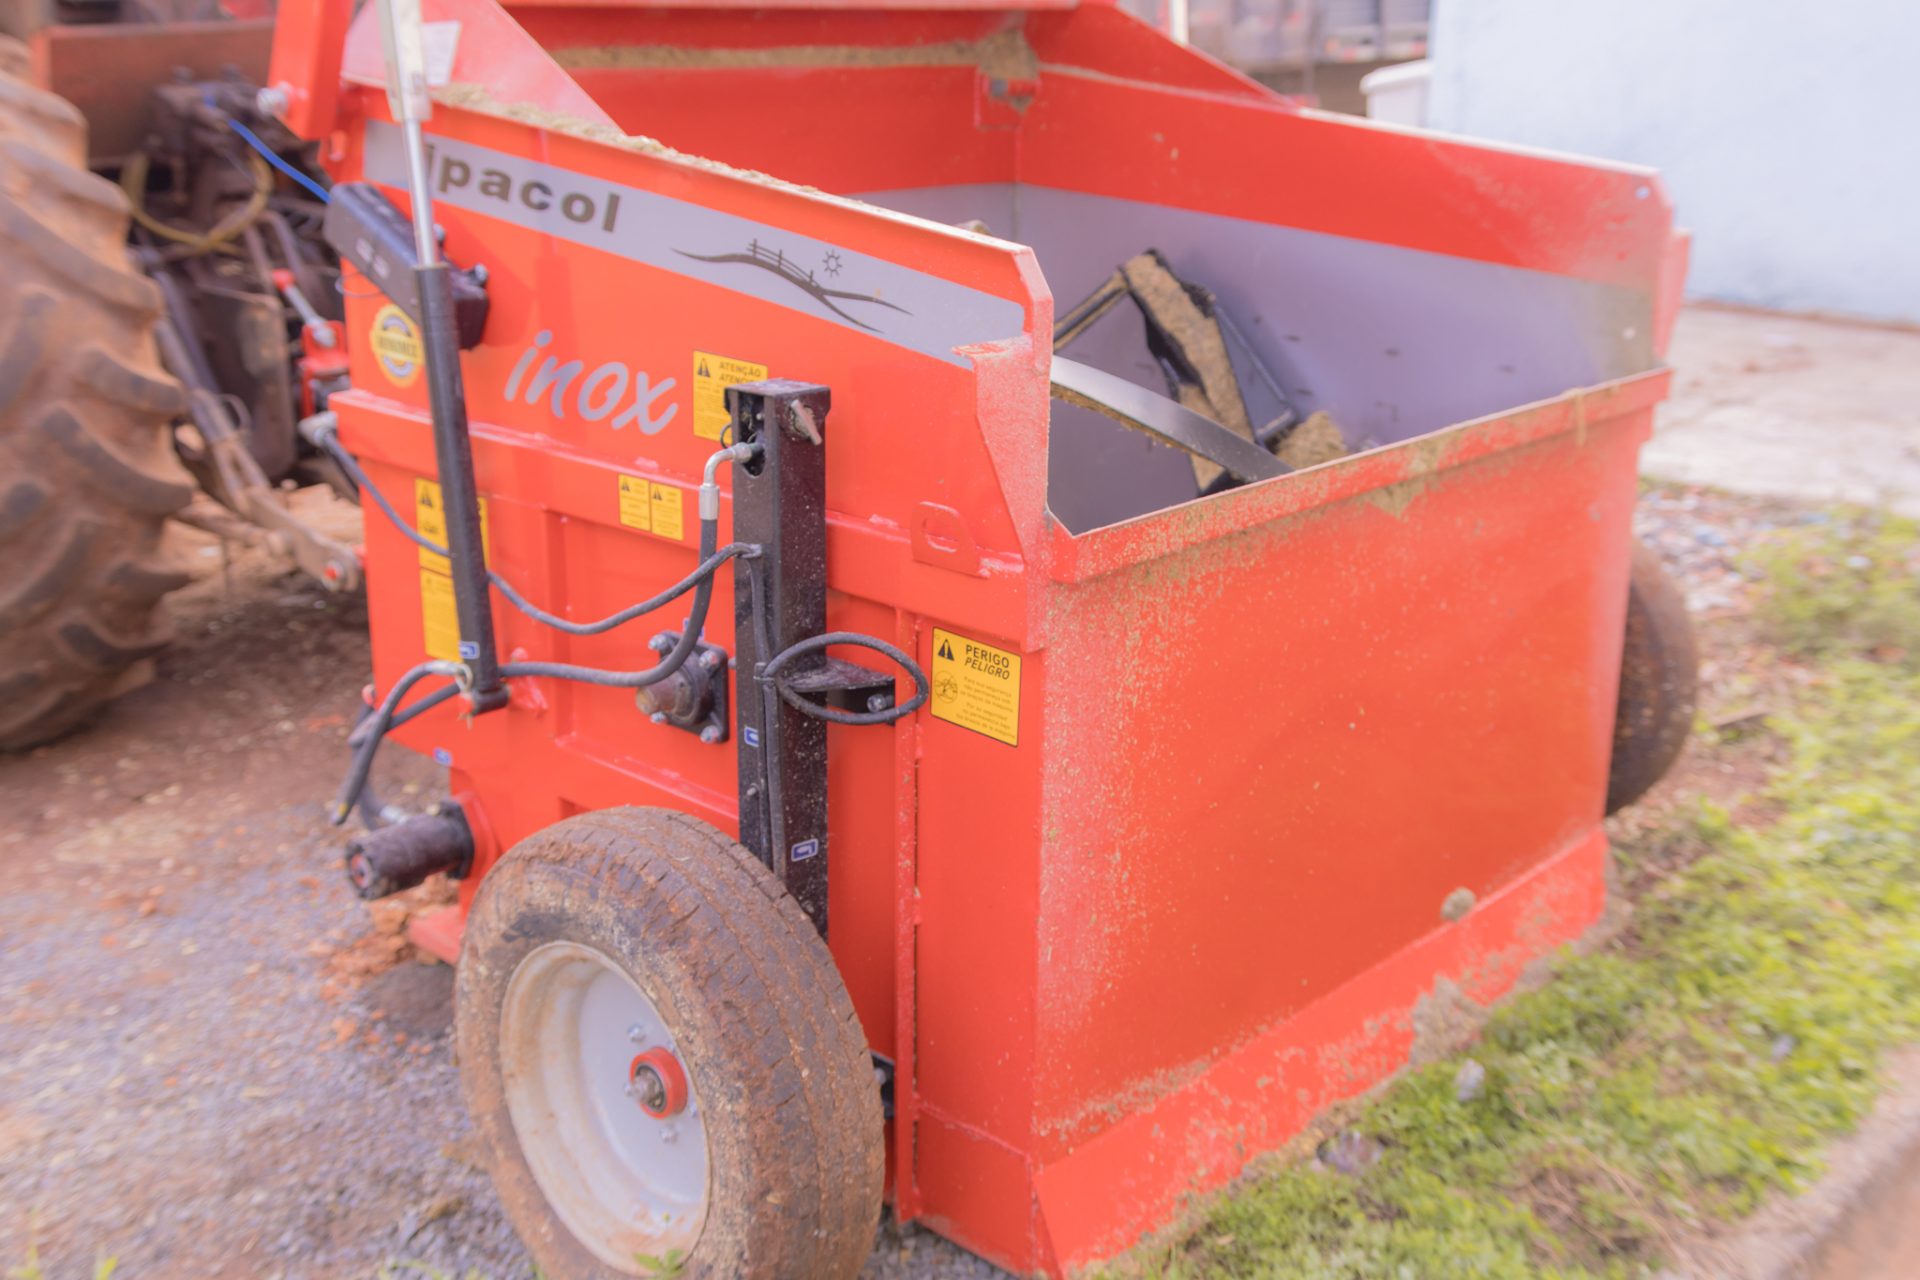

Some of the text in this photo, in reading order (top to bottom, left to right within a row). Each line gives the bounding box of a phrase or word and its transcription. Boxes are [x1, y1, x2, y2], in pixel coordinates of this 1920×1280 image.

[719, 361, 762, 378] ATENÇÃO
[503, 329, 679, 436] inox
[964, 656, 1010, 681] PELIGRO
[965, 644, 1010, 669] PERIGO
